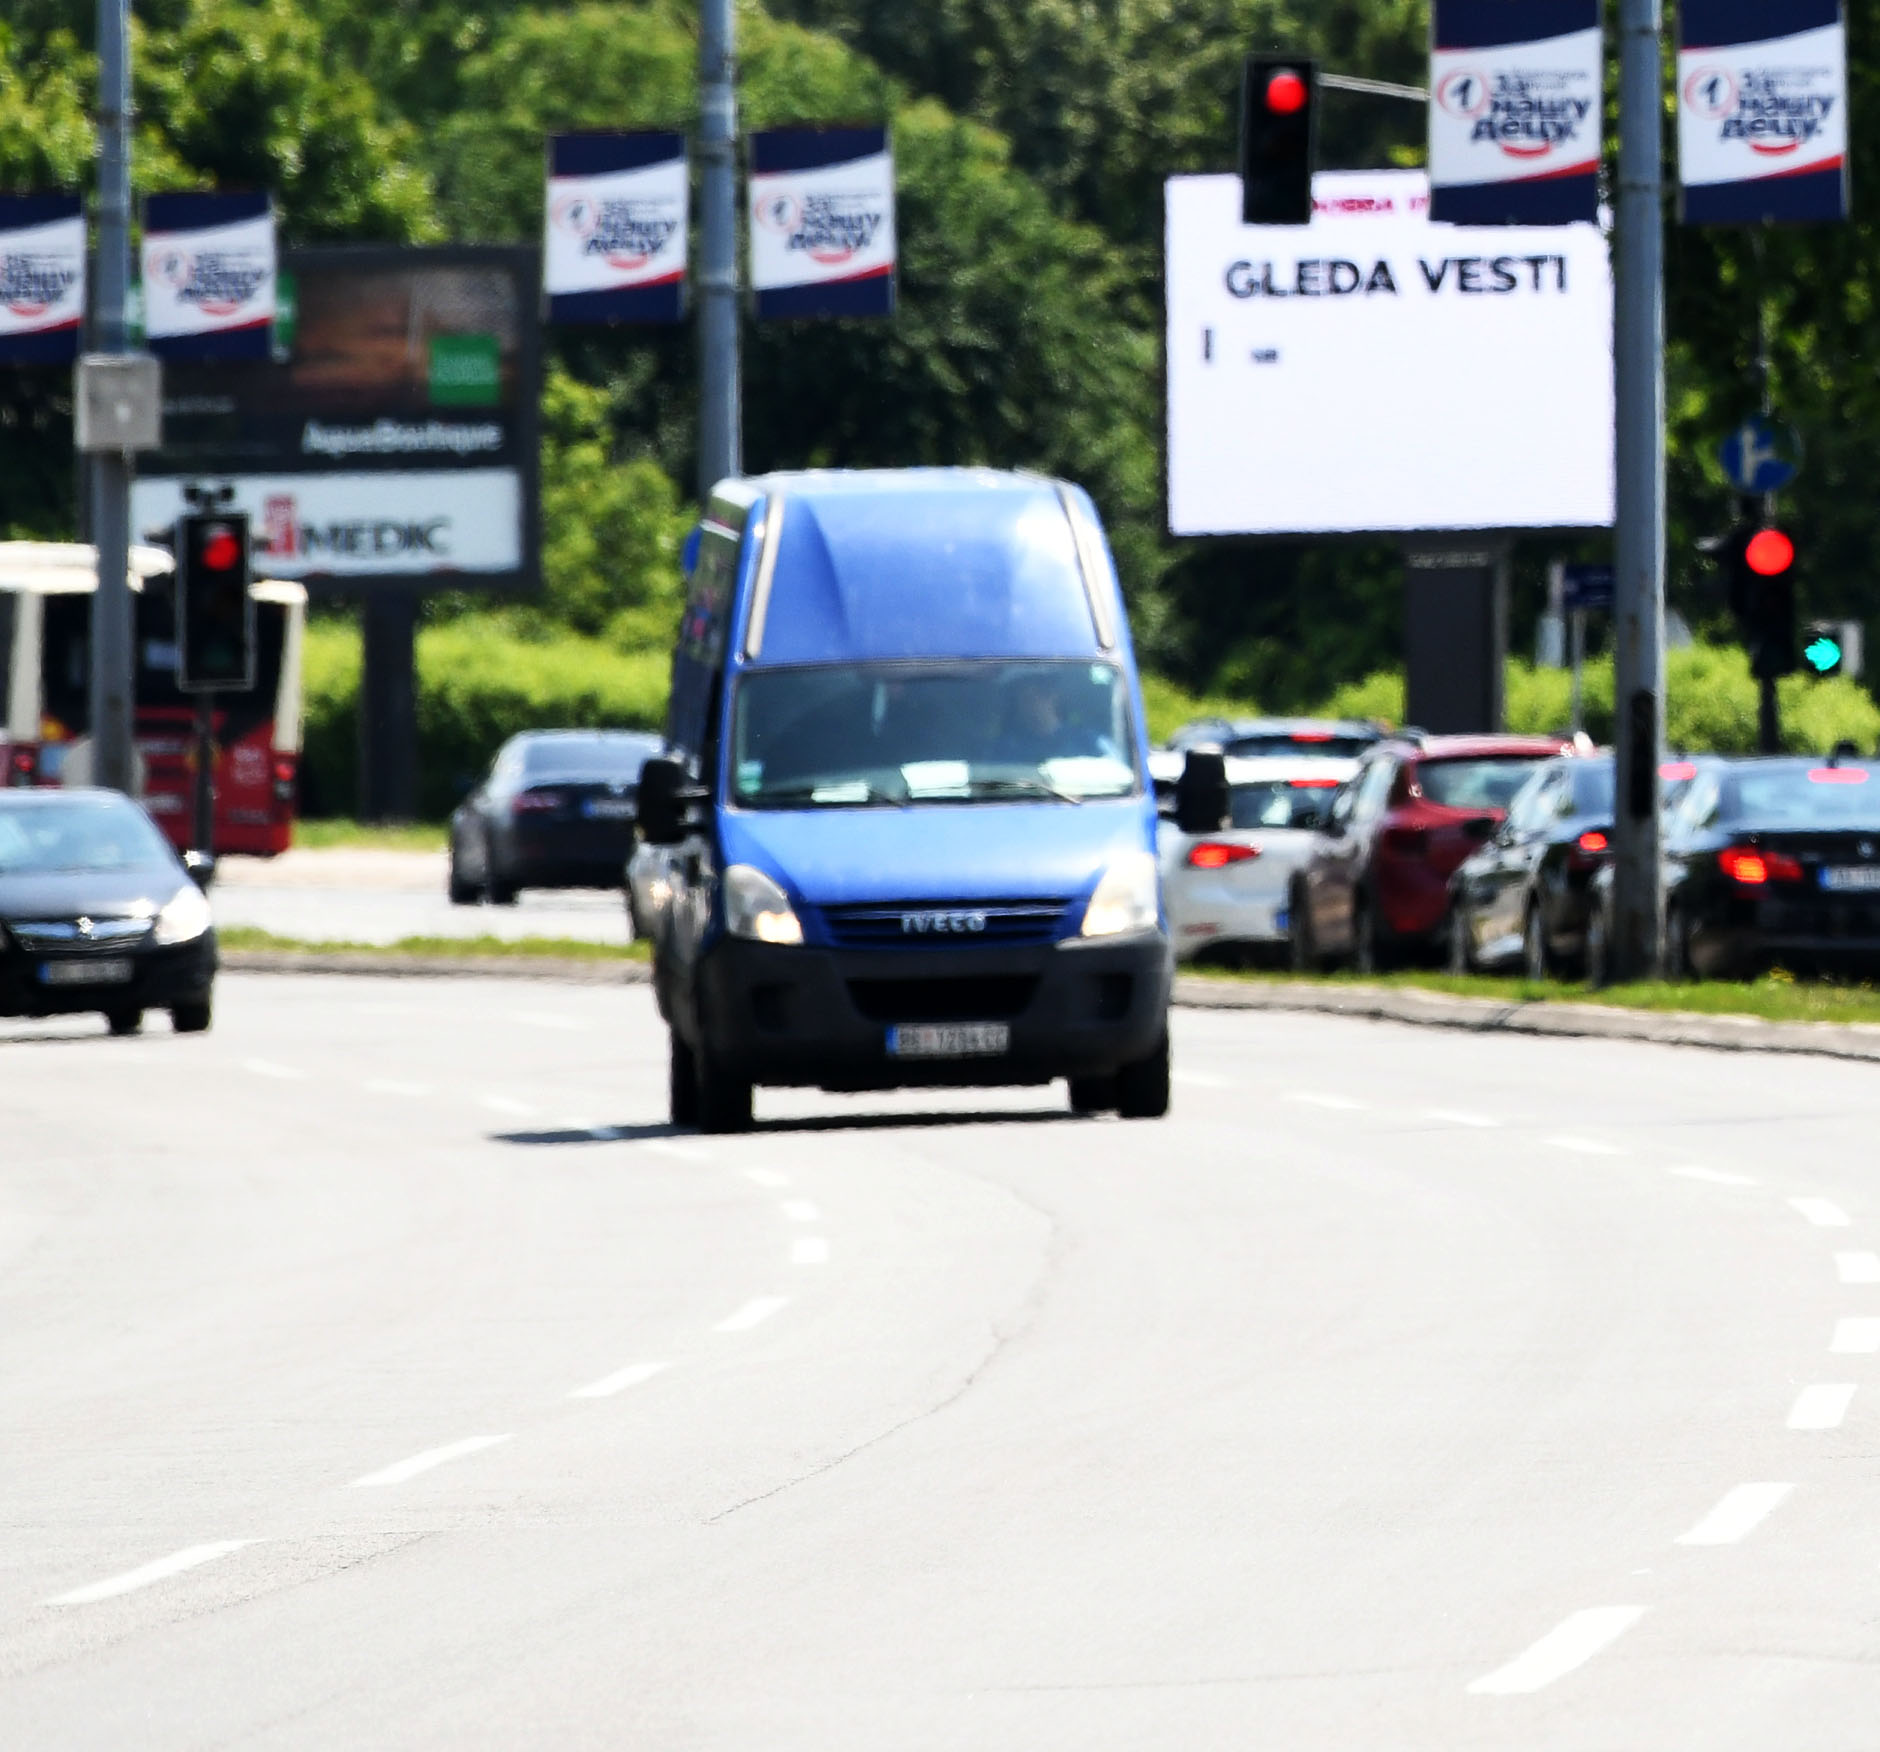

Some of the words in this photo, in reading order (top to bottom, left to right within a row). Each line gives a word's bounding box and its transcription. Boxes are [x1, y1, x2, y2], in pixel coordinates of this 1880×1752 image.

[1225, 258, 1399, 298] GLEDA
[1418, 255, 1565, 294] VESTI
[902, 911, 986, 933] IVECO
